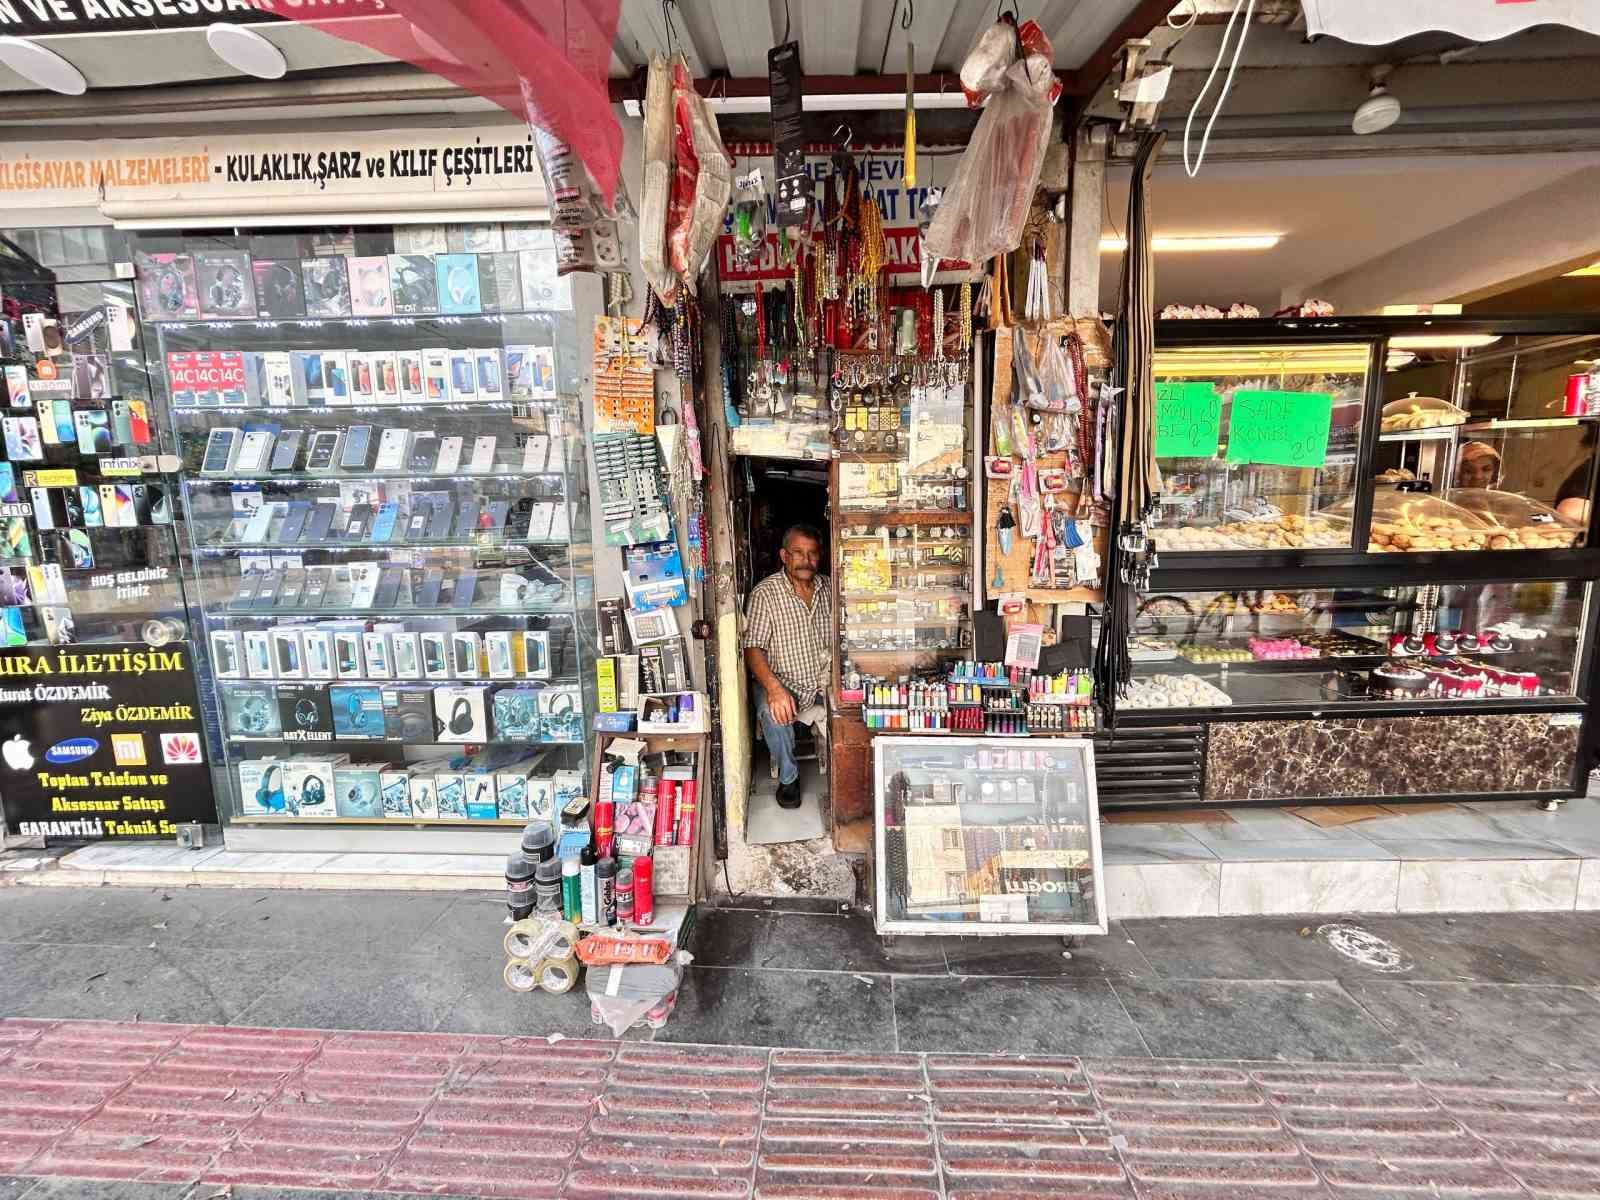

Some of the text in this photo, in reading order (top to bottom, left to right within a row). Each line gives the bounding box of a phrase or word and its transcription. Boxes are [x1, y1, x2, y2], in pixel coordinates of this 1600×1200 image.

[22, 0, 78, 22] VE
[91, 145, 210, 187] MALZEMELERİ
[226, 151, 361, 189] KULAKLIK,ŞARZ
[365, 159, 385, 178] ve
[389, 149, 437, 177] KILIF
[442, 134, 534, 185] ÇEŞİTLERİ
[91, 566, 169, 587] HOŞ GELDİNİZ
[57, 648, 184, 675] İLETİŞİM
[34, 682, 111, 701] ÖZDEMİR
[80, 702, 194, 727] Ziya ÖZDEMİR
[51, 745, 94, 756] SAMSUNG
[91, 771, 147, 786] Telefon
[150, 775, 168, 785] ve
[52, 796, 165, 813] Aksesuar Satışı
[20, 818, 176, 836] GARANTİLİ Teknik Se
